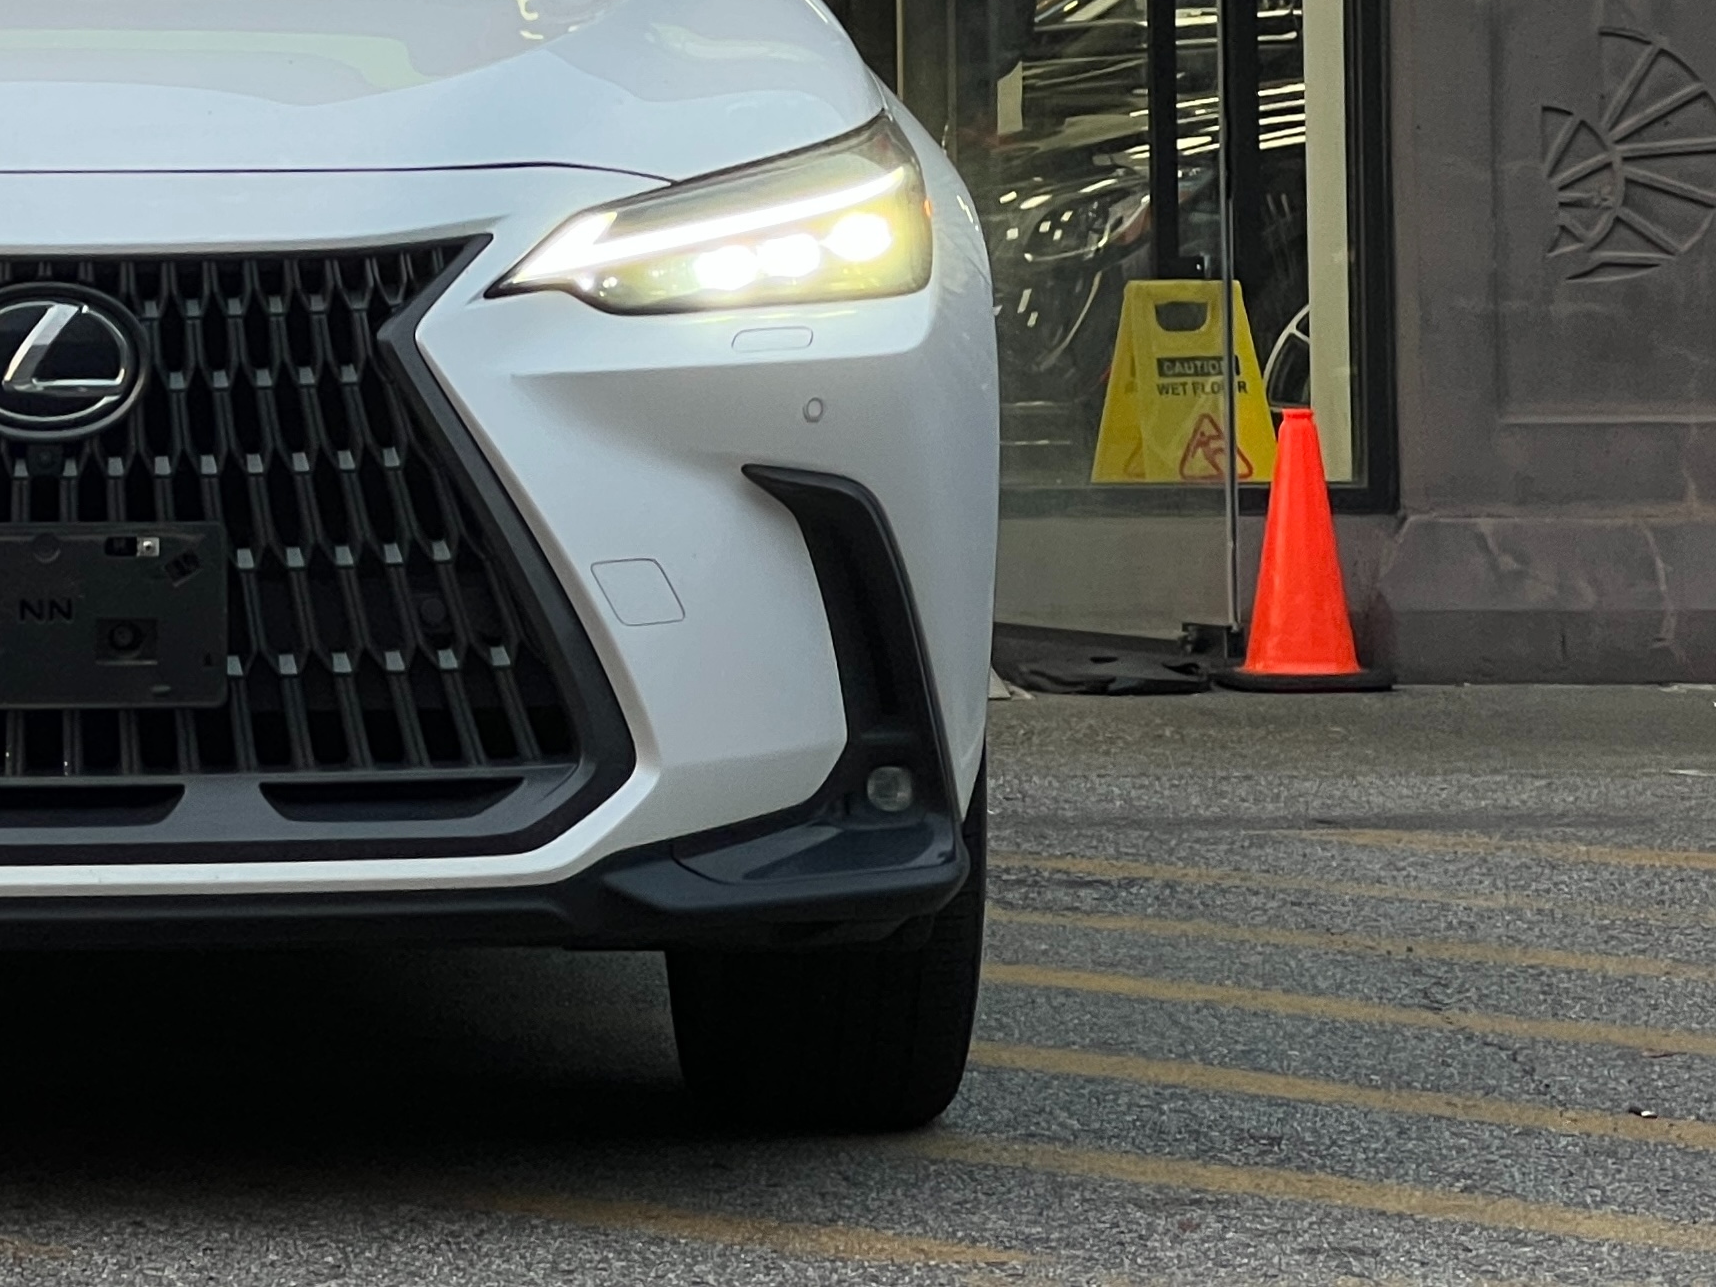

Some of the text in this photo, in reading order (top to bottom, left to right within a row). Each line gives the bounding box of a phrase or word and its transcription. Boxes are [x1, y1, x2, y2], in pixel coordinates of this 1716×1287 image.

[1156, 380, 1248, 396] WET FLOR
[19, 598, 74, 621] NN
